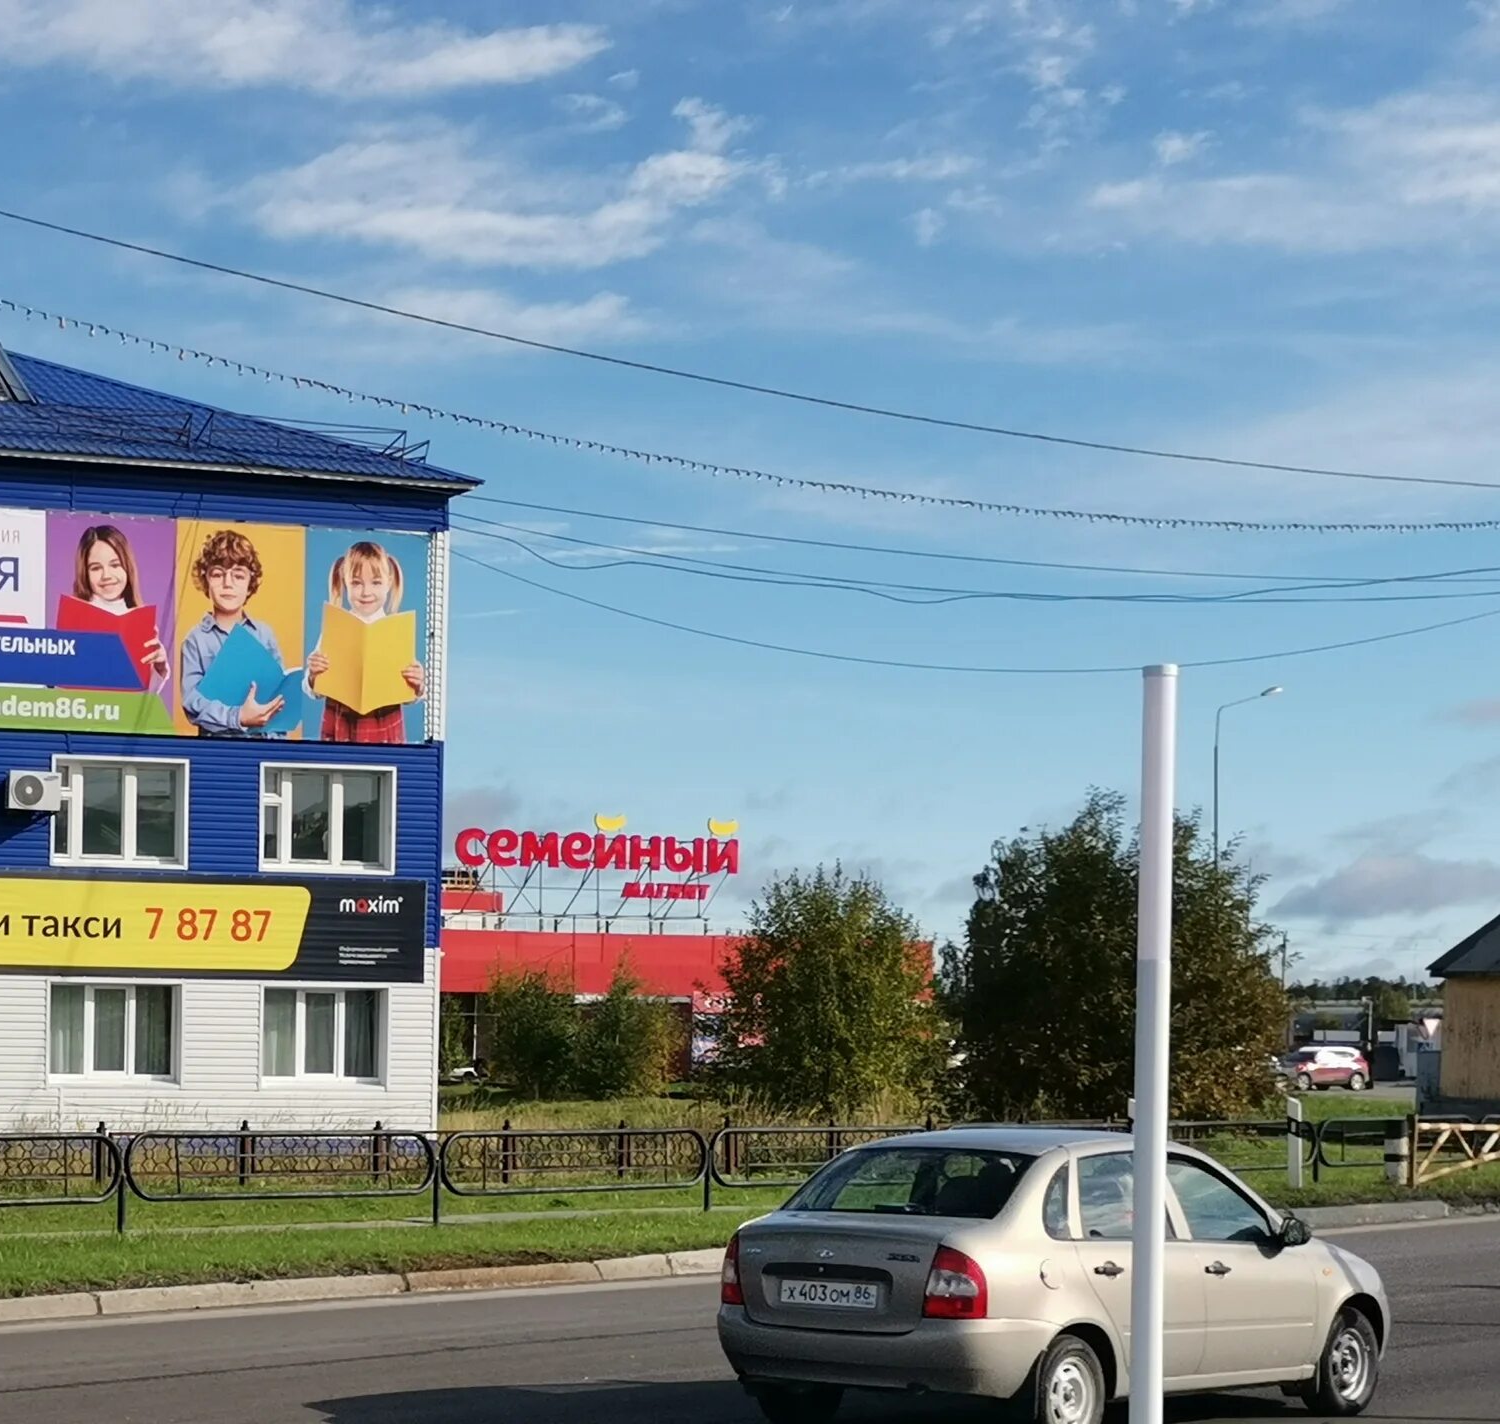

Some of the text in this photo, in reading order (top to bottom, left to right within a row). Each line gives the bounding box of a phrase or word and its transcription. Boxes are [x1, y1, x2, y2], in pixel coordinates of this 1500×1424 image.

[620, 882, 711, 900] МАГНИТ
[339, 895, 400, 914] maxim
[21, 914, 121, 939] такси
[145, 907, 164, 940] 7
[176, 907, 218, 941] 87
[230, 909, 272, 942] 87
